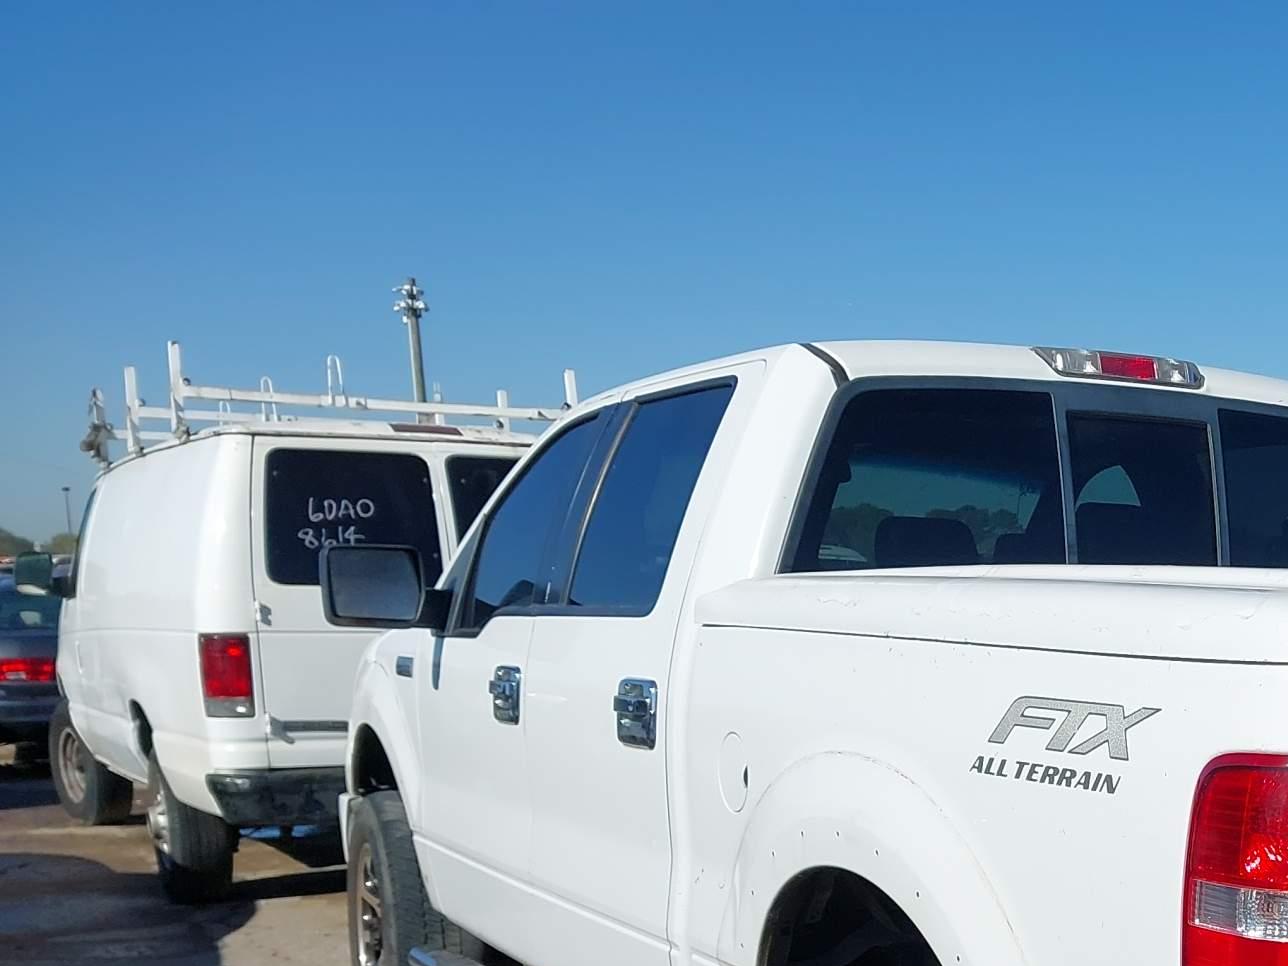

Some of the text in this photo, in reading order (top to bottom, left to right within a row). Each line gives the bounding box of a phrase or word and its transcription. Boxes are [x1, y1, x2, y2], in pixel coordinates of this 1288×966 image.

[987, 695, 1162, 761] FTX
[969, 755, 1121, 794] ALL TERRAIN
